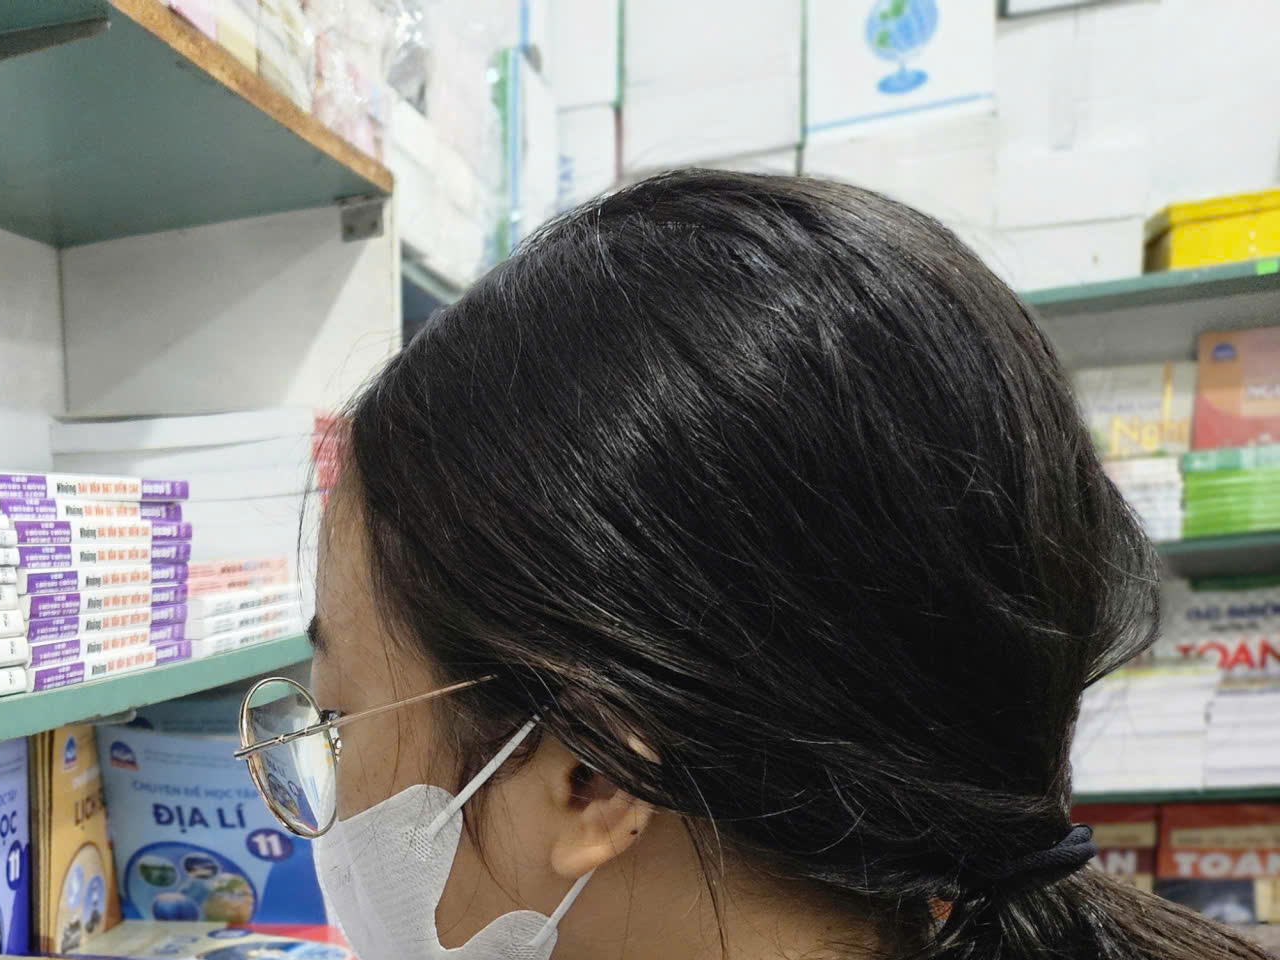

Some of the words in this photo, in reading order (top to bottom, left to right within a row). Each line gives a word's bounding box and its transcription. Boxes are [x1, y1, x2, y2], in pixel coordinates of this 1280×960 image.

[152, 802, 210, 834] ĐỊA
[217, 803, 246, 829] LÍ
[251, 833, 282, 857] 11
[8, 849, 20, 881] 11
